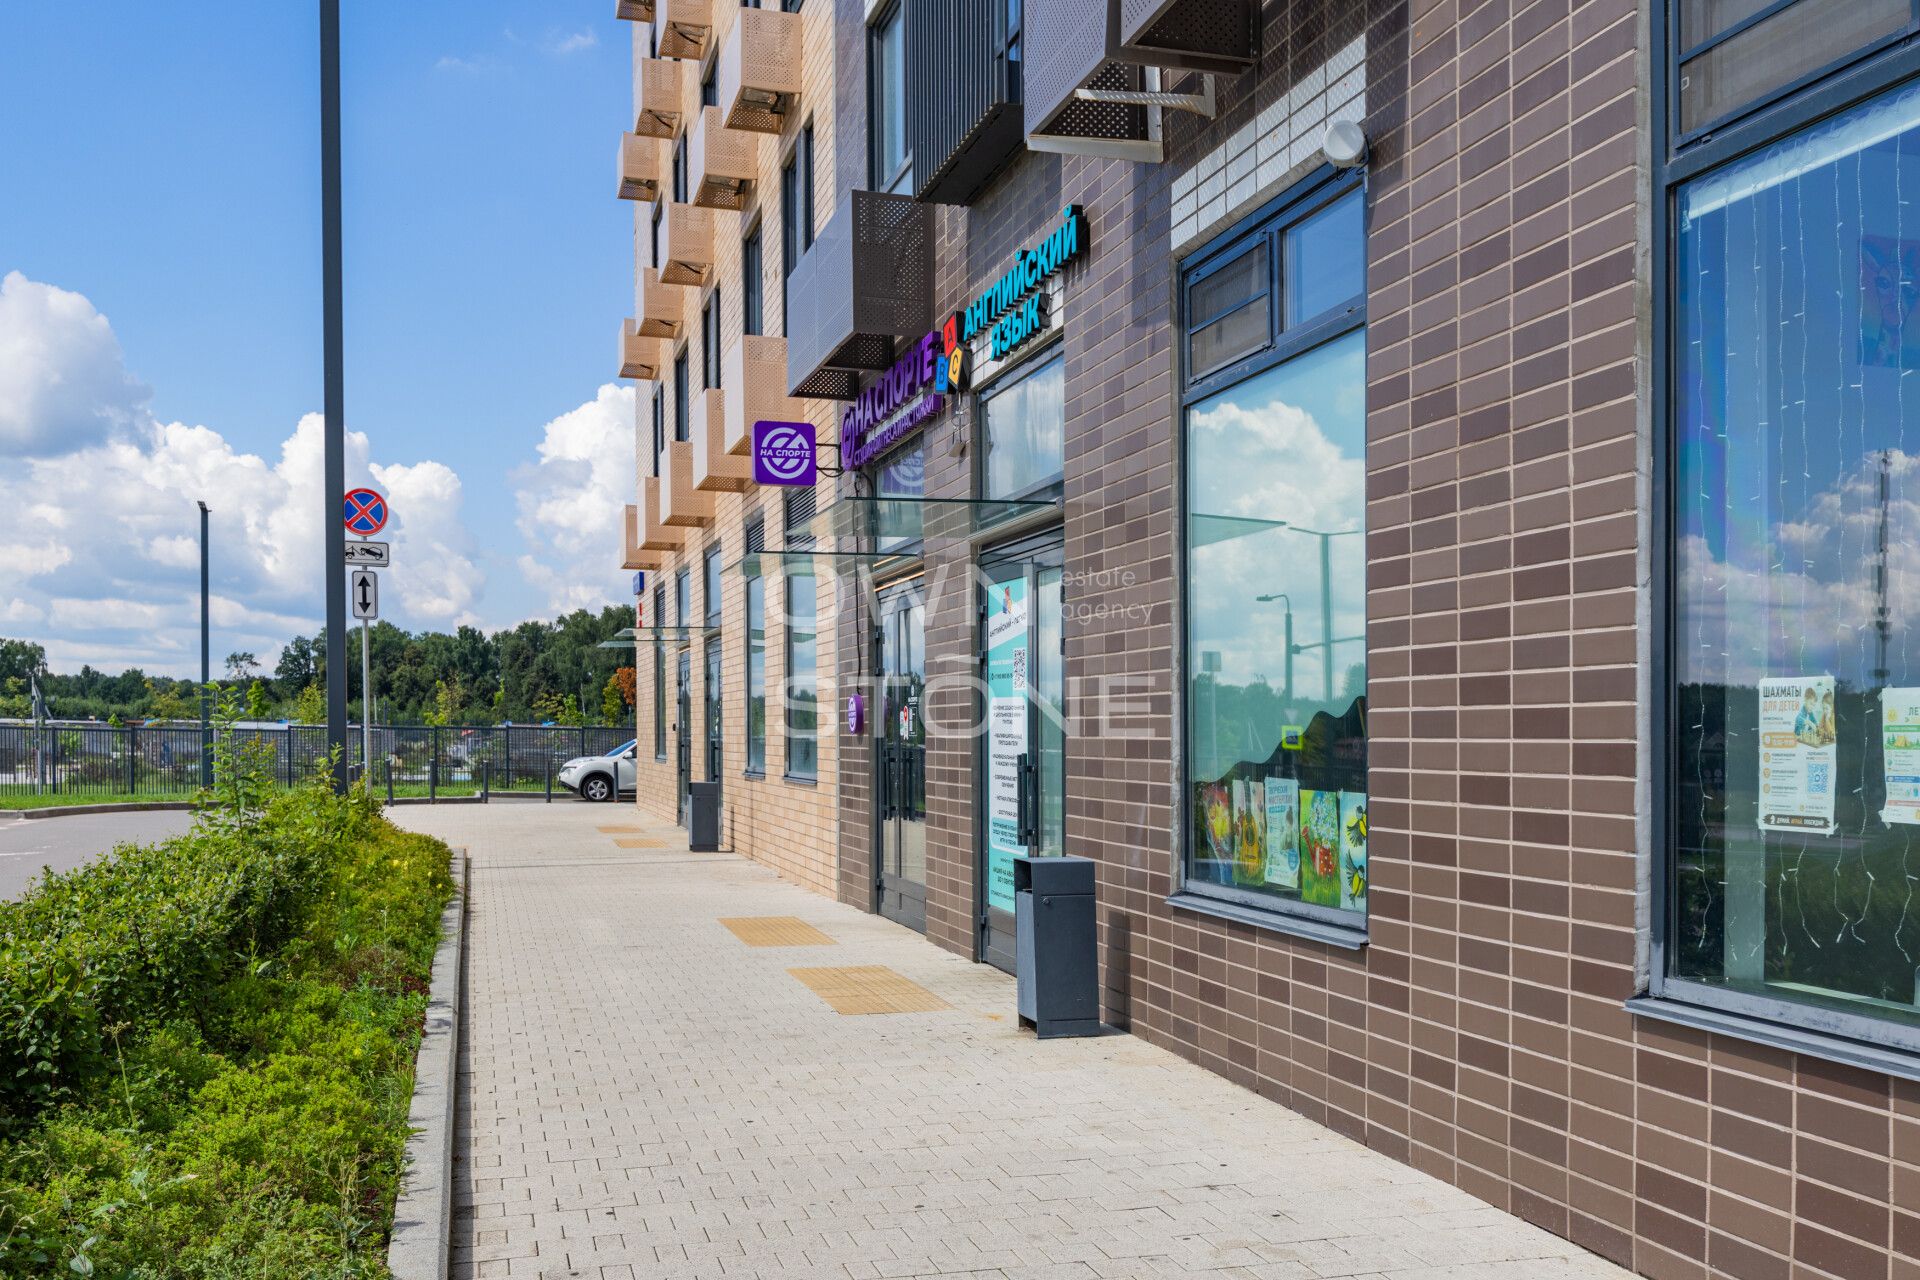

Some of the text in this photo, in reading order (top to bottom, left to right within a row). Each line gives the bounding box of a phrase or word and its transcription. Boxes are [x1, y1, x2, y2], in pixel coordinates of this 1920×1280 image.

[963, 204, 1077, 341] АНГЛИЙСКИЙ
[990, 293, 1040, 361] ЯЗЫК
[776, 449, 811, 457] СПОРТЕ
[1763, 685, 1802, 698] ШАХМАТЫ
[1763, 700, 1800, 712] ДЛЯ ДЕТЕЙ
